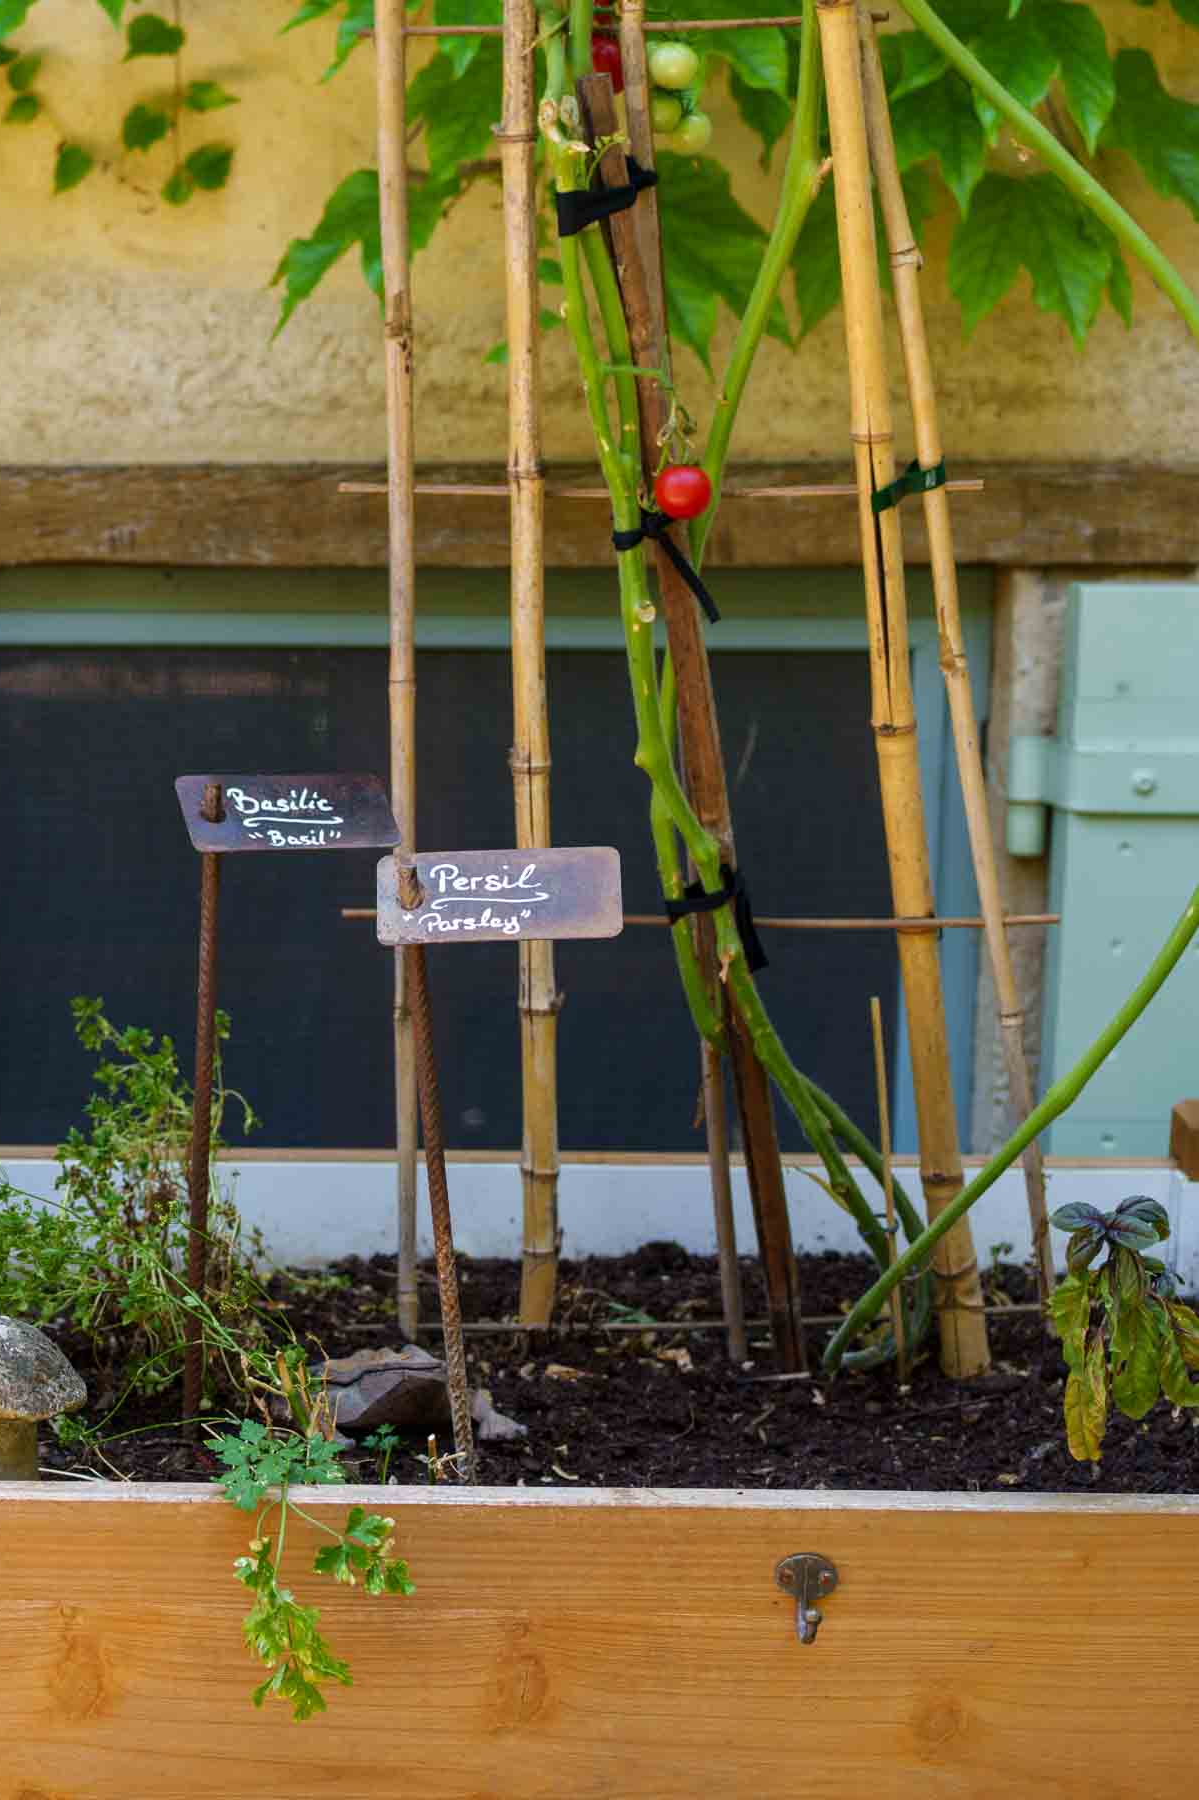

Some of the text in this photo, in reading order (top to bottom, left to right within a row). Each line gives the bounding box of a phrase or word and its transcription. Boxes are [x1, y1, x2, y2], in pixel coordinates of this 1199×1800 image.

[226, 787, 334, 814] Basilic
[248, 829, 342, 847] "Basil"
[429, 863, 542, 893] Persil
